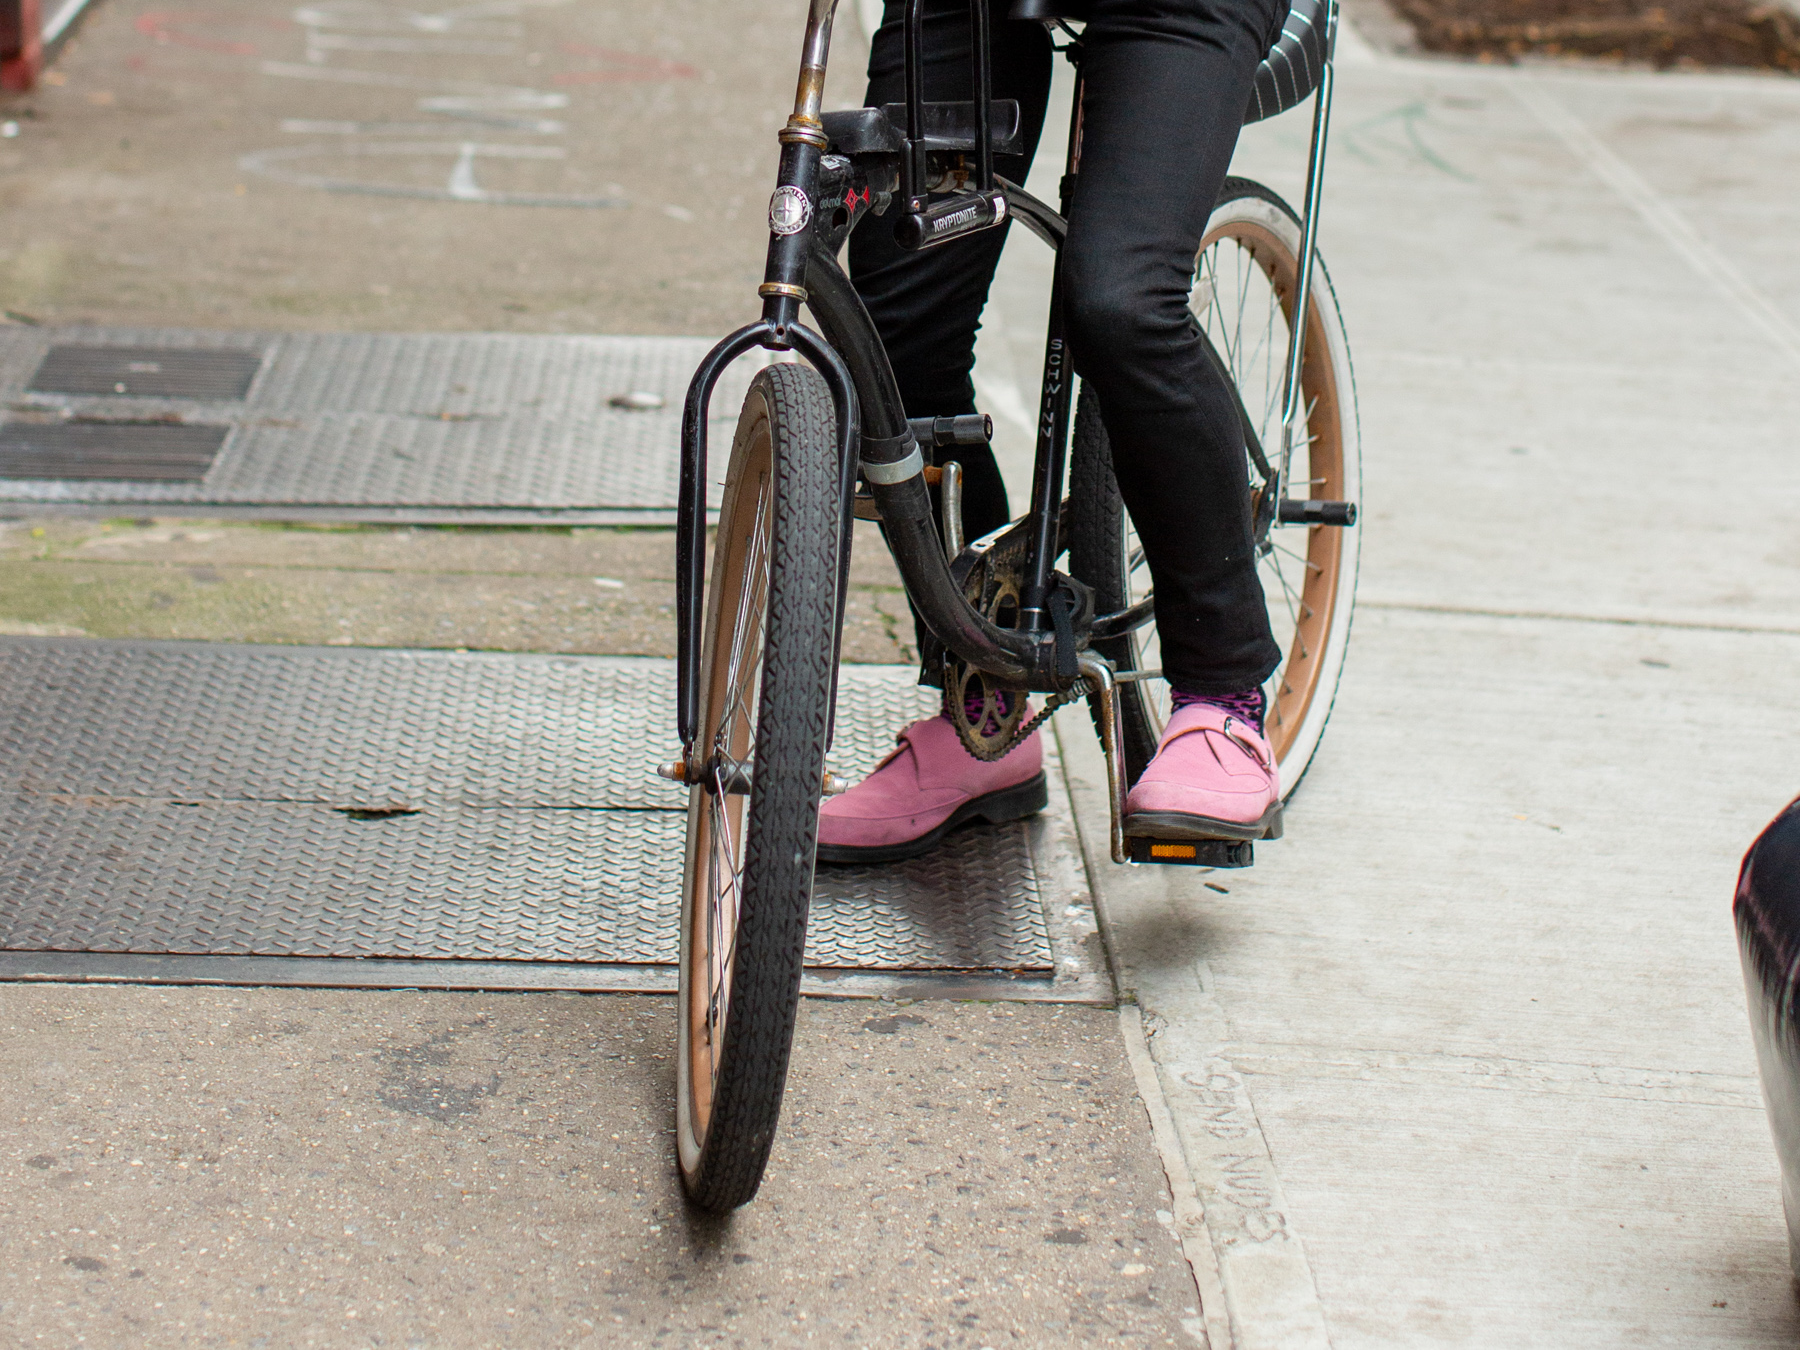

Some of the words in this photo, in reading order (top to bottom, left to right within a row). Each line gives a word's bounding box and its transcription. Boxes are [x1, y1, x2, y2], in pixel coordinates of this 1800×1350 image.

[932, 206, 977, 233] KRYPTONITE
[1039, 338, 1063, 438] SCHWINN
[1180, 1065, 1249, 1140] SEND
[1212, 1152, 1290, 1243] NUDES
